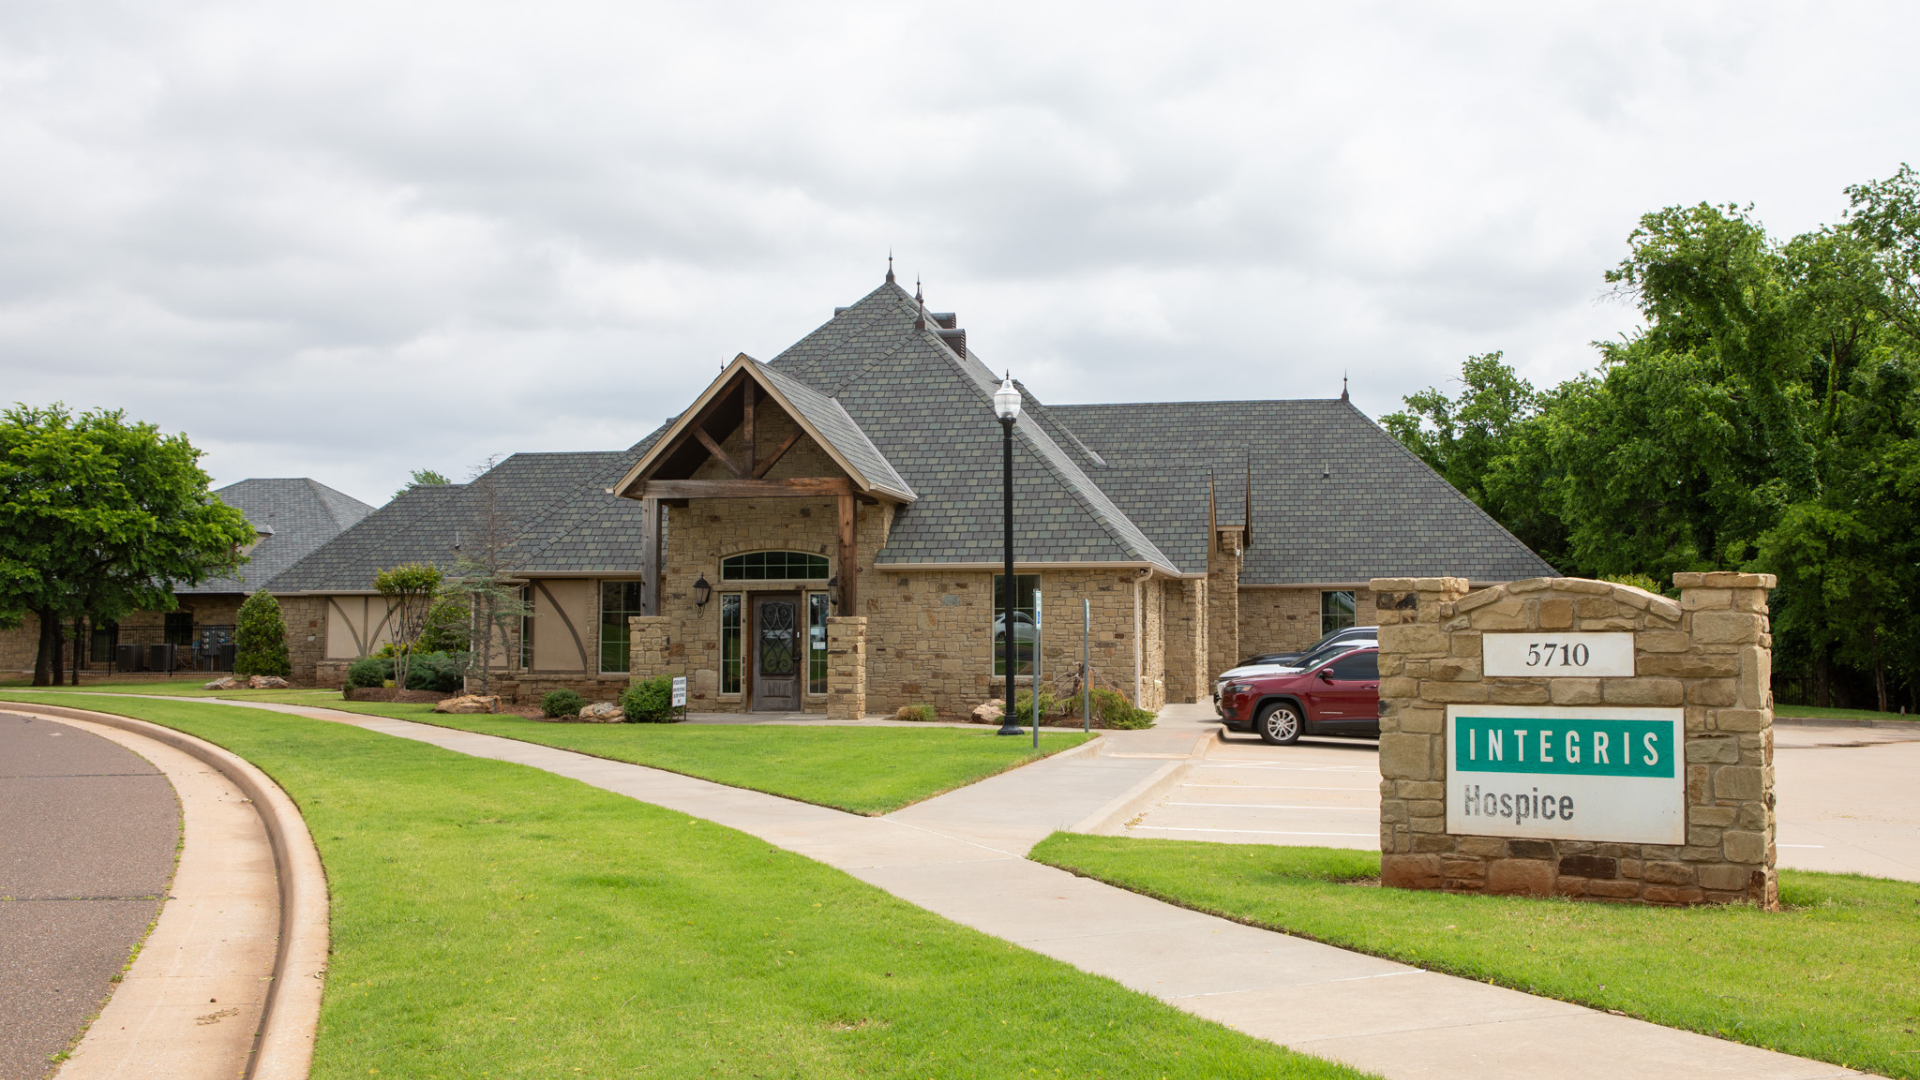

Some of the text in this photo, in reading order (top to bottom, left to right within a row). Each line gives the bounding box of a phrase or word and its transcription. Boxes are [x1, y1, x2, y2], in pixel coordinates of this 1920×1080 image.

[1525, 642, 1590, 667] 5710
[1469, 728, 1659, 766] INTEGRIS
[1464, 784, 1574, 825] Hospice
